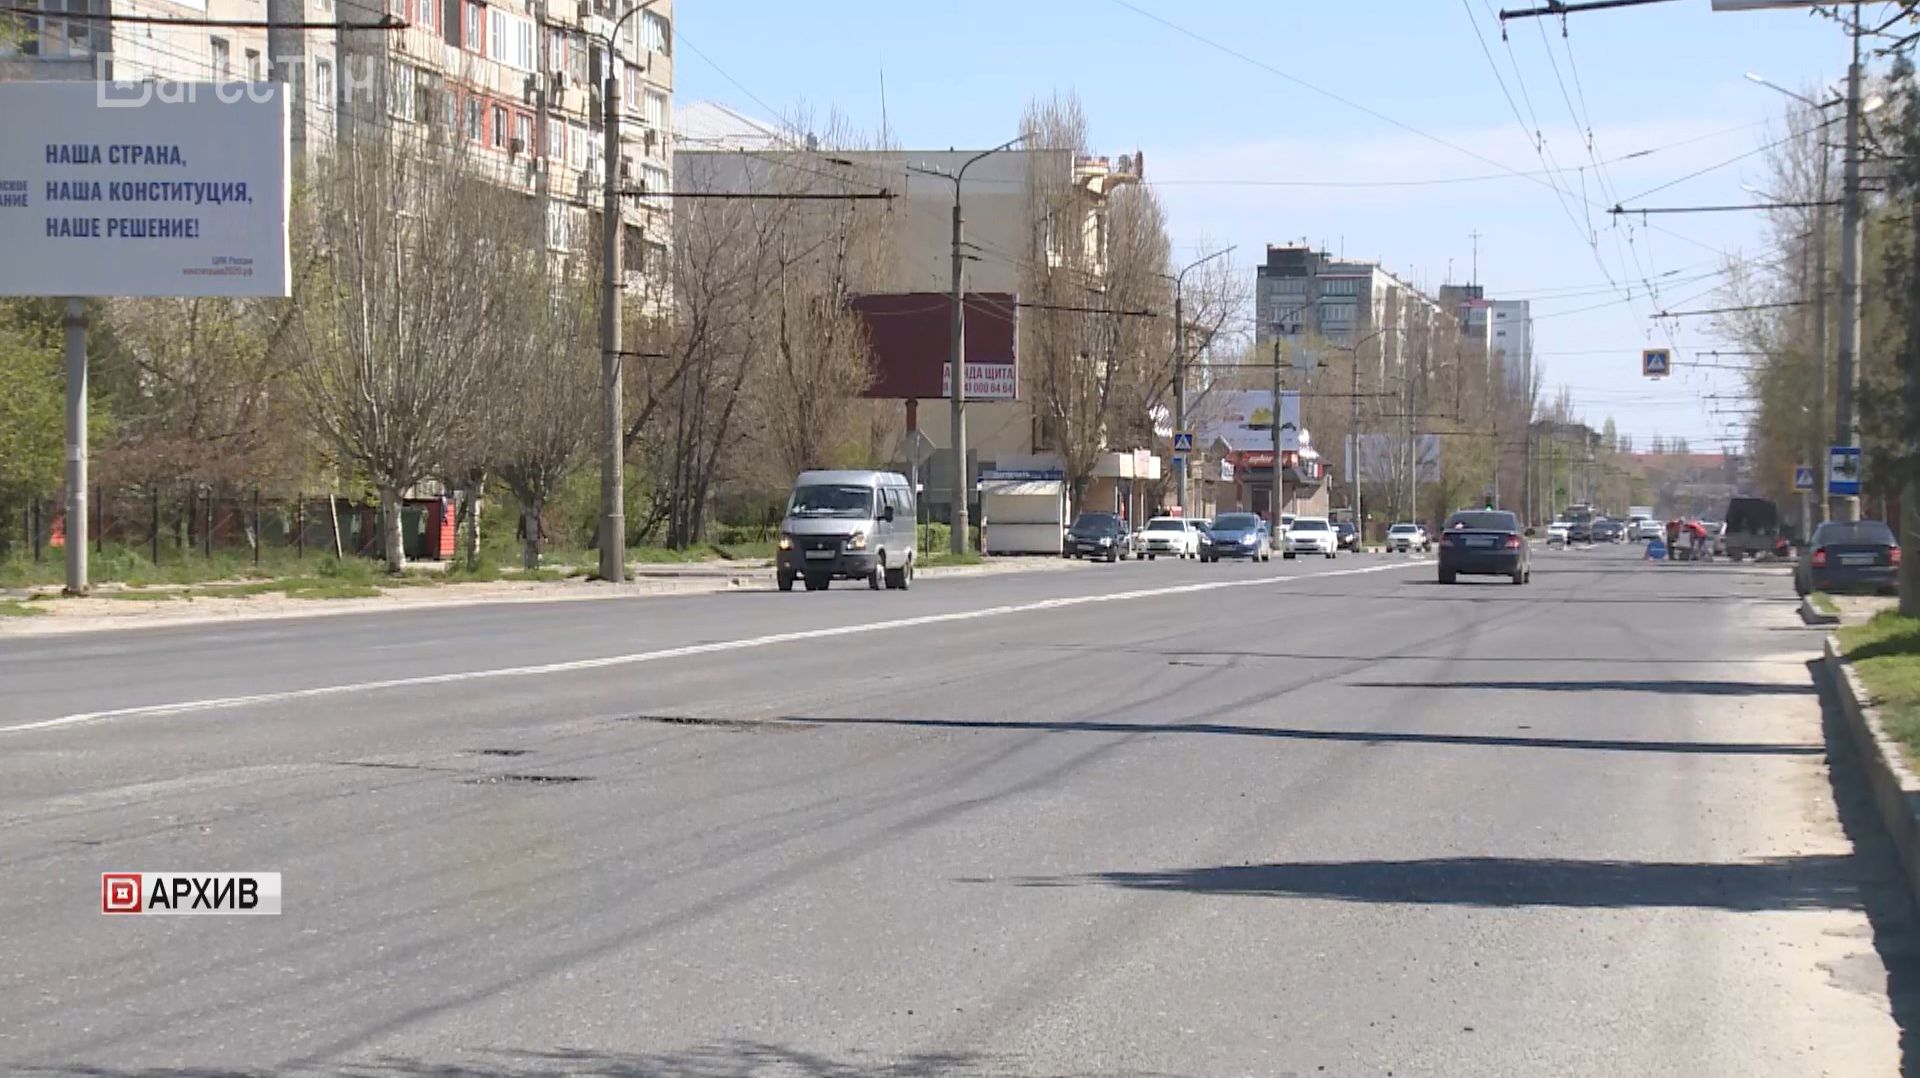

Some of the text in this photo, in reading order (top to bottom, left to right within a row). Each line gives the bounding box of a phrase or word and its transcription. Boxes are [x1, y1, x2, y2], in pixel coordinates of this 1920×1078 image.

[46, 144, 187, 167] НАША СТРАНА,
[46, 181, 253, 205] НАША КОНСТИТУЦИЯ,
[46, 217, 200, 238] НАШЕ РЕШЕНИЕ!
[985, 366, 1014, 380] ЩИТА
